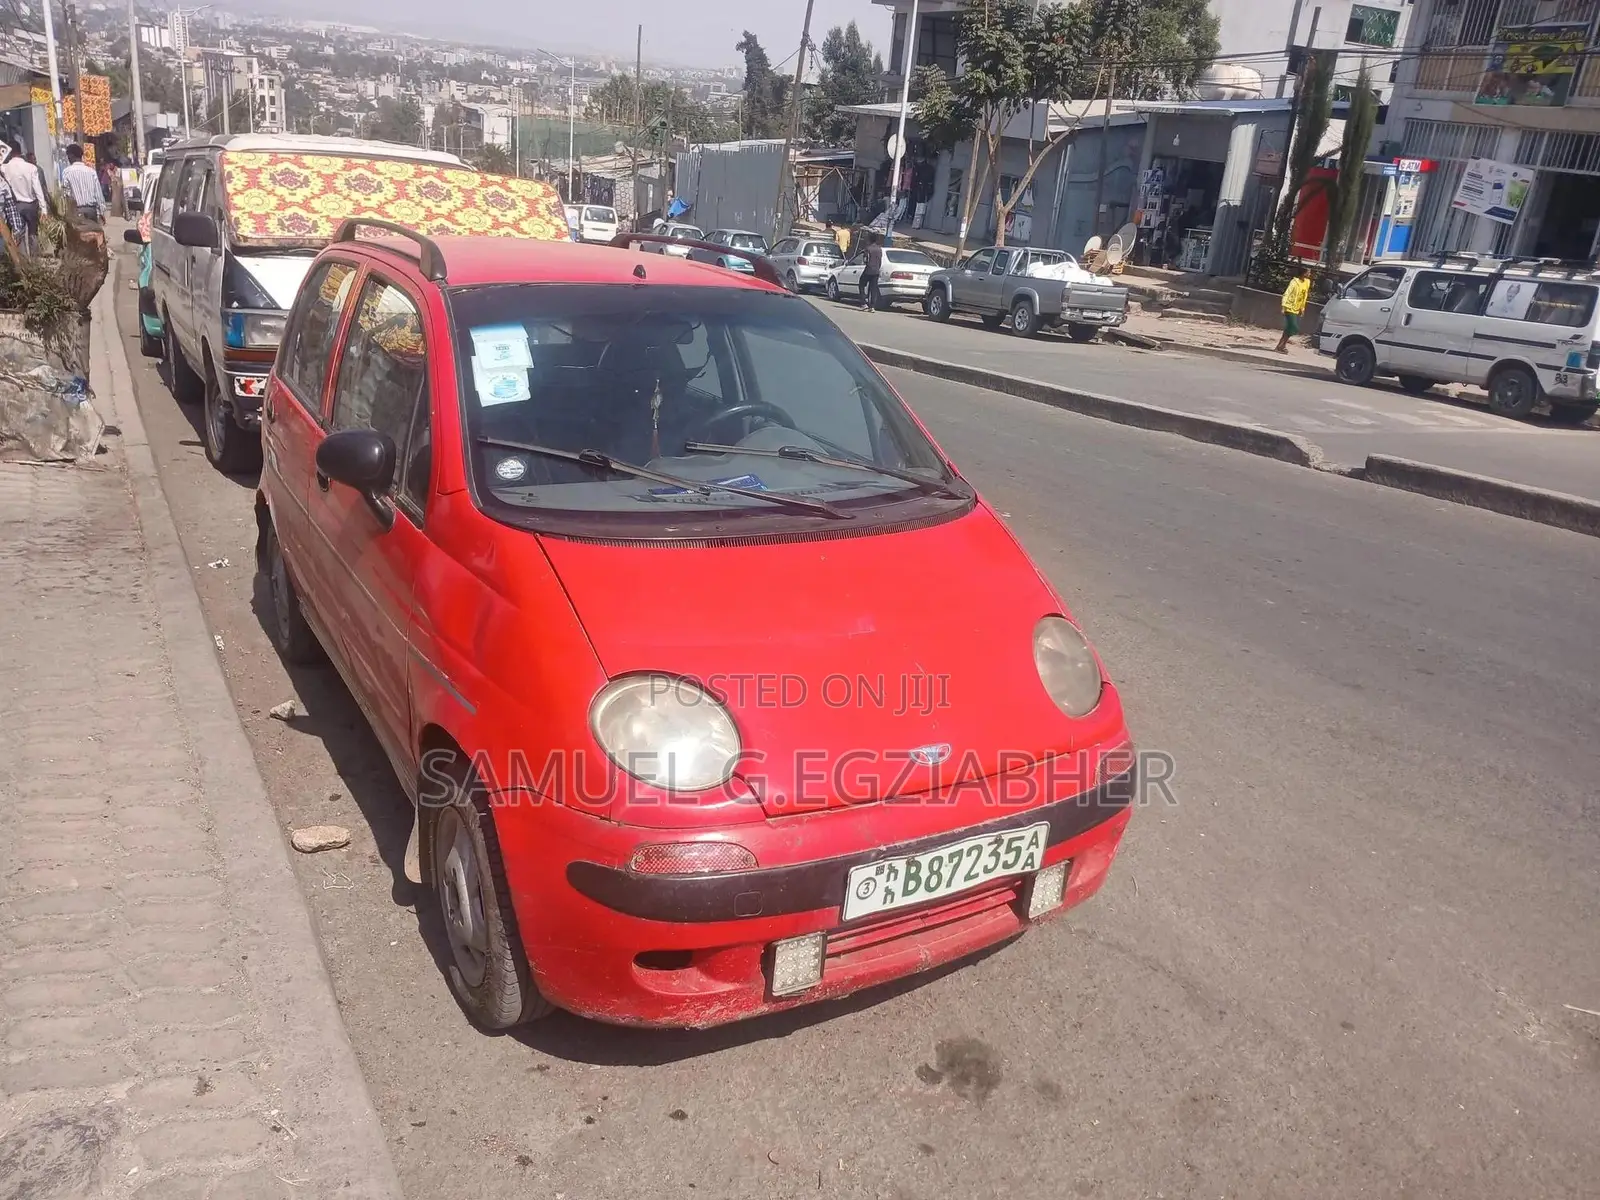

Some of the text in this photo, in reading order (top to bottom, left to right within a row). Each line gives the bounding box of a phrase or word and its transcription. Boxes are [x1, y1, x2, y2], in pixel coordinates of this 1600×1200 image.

[1528, 29, 1556, 40] Game
[1406, 161, 1421, 170] ATM
[901, 836, 1026, 898] B87235
